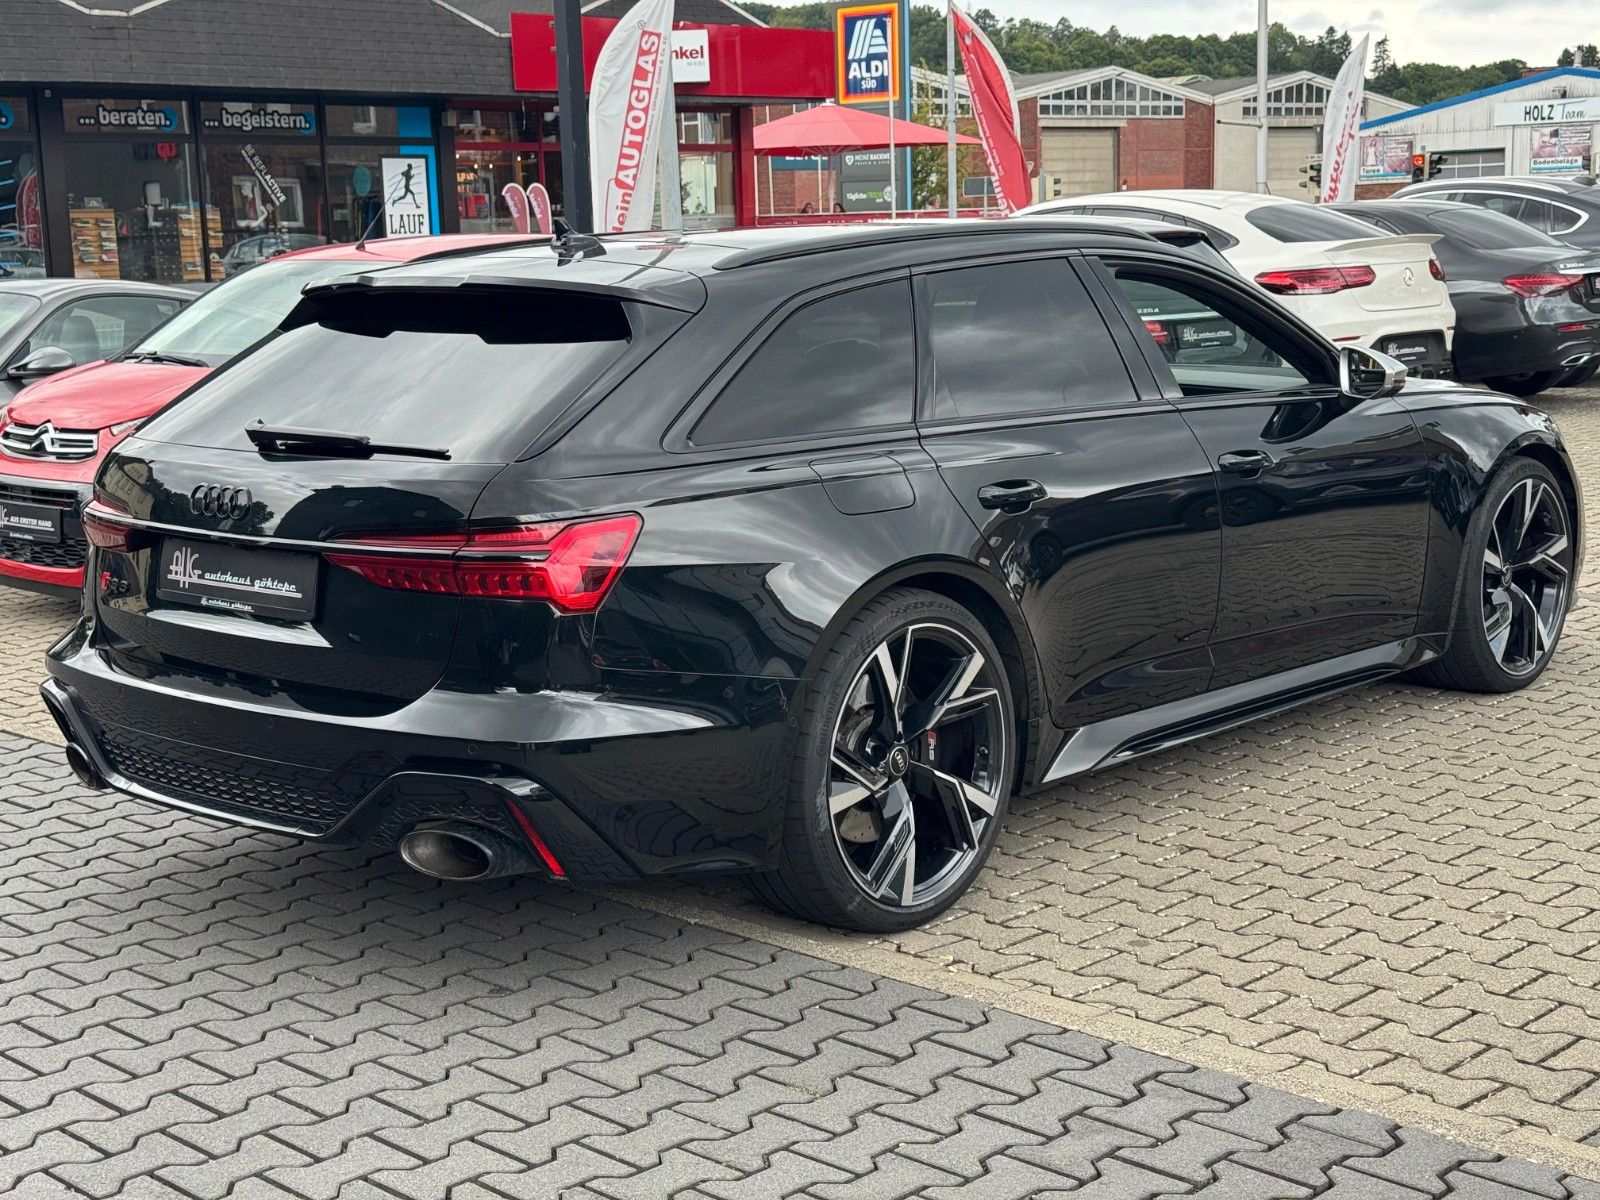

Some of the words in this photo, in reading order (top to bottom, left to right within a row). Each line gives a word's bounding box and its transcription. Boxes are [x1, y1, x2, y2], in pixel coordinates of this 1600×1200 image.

[848, 60, 889, 79] ALDI
[861, 78, 877, 90] SÜD
[616, 33, 660, 191] AUTOGLAS
[1524, 104, 1554, 122] HOLZ
[1557, 99, 1587, 120] Team
[389, 214, 425, 235] LAUF
[204, 571, 252, 586] autohaus
[254, 578, 298, 593] göktepe
